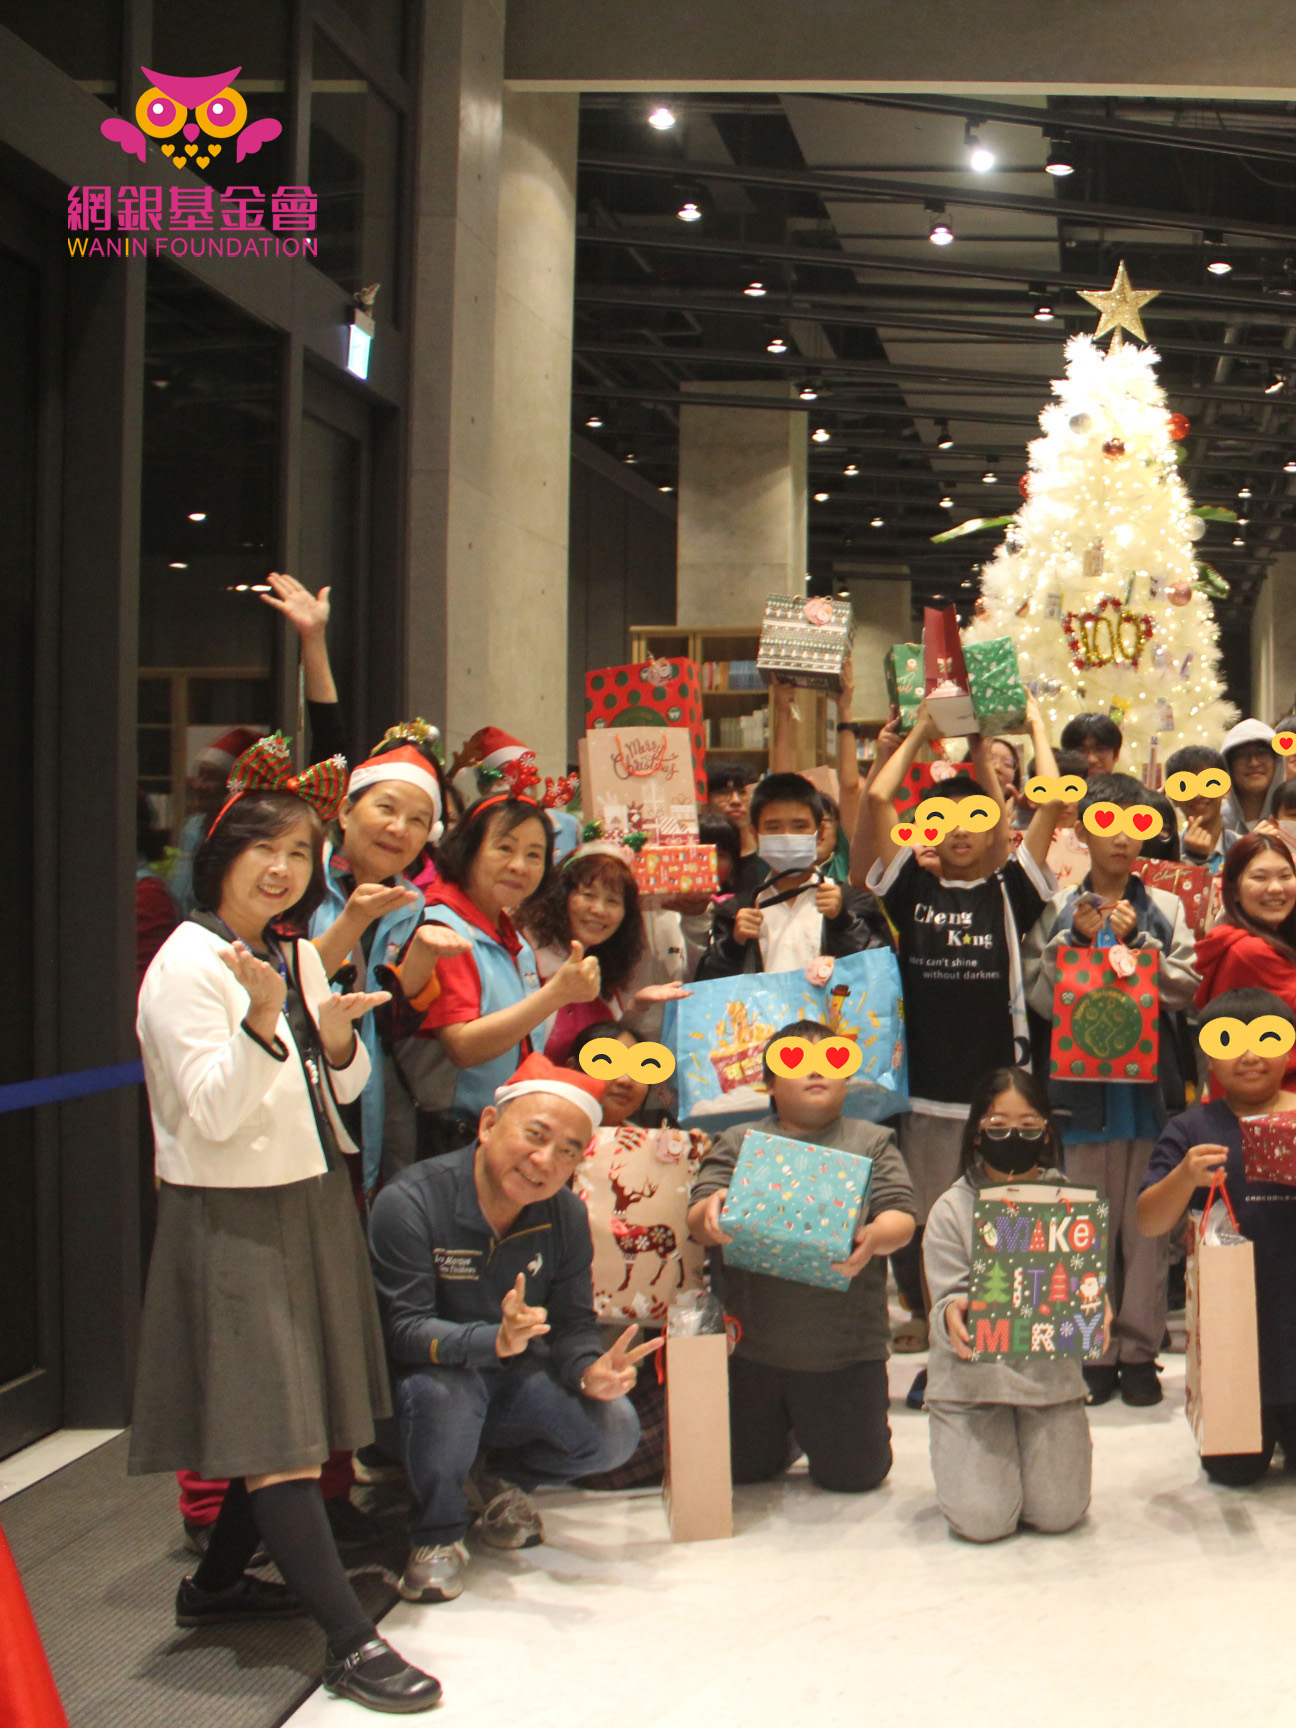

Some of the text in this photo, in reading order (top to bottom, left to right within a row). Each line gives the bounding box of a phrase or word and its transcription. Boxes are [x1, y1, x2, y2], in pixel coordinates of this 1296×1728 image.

[625, 738, 664, 758] Merry
[926, 957, 949, 967] can't
[951, 957, 978, 967] shine
[923, 970, 960, 979] without
[975, 1313, 1102, 1354] MERRY
